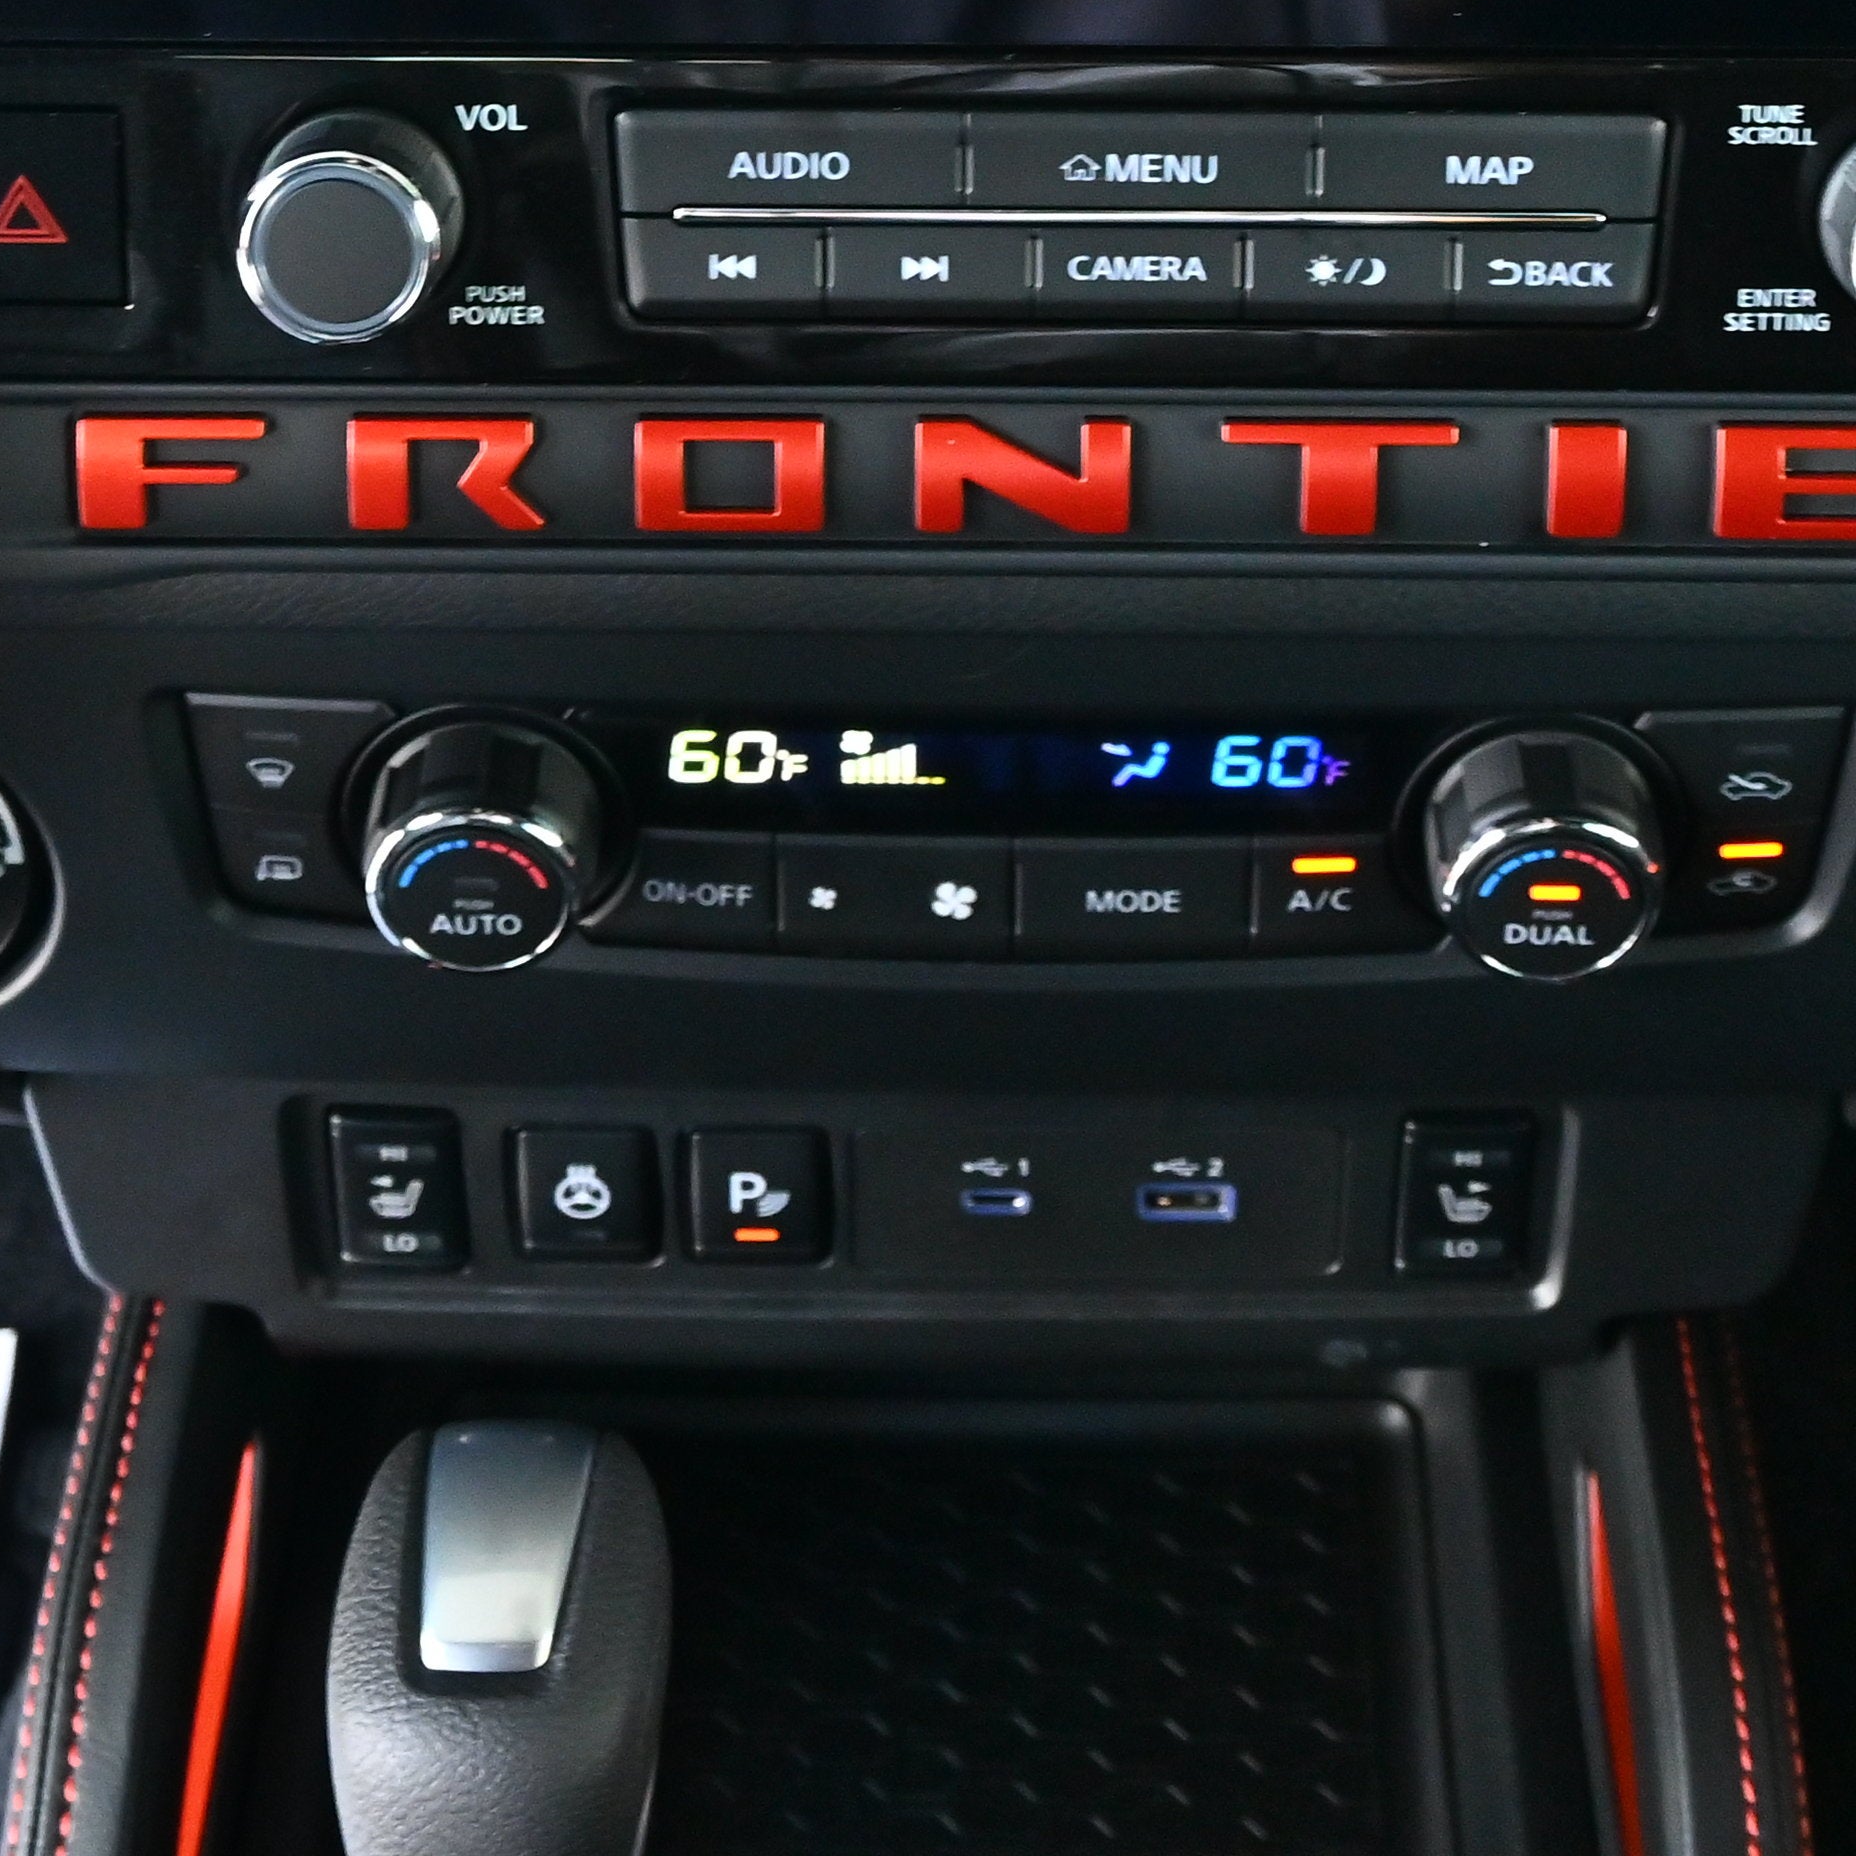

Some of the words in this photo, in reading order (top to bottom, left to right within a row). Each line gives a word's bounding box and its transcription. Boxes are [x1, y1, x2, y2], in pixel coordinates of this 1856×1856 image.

[454, 104, 528, 132] VOL
[1737, 104, 1806, 124] TUNE
[1727, 126, 1819, 145] SCROLL
[727, 150, 851, 181] AUDIO
[1104, 153, 1219, 185] MENU
[1445, 155, 1535, 186] MAP
[1066, 254, 1208, 283] CAMERA
[1523, 261, 1615, 289] BACK
[464, 285, 527, 303] PUSH
[1737, 288, 1817, 308] ENTER
[448, 306, 546, 326] POWER
[1723, 313, 1832, 332] SETTING
[643, 880, 754, 908] ON-OFF
[1086, 888, 1183, 914] MODE
[1287, 886, 1354, 913] A/C
[429, 912, 523, 936] AUTO
[1504, 922, 1597, 946] DUAL
